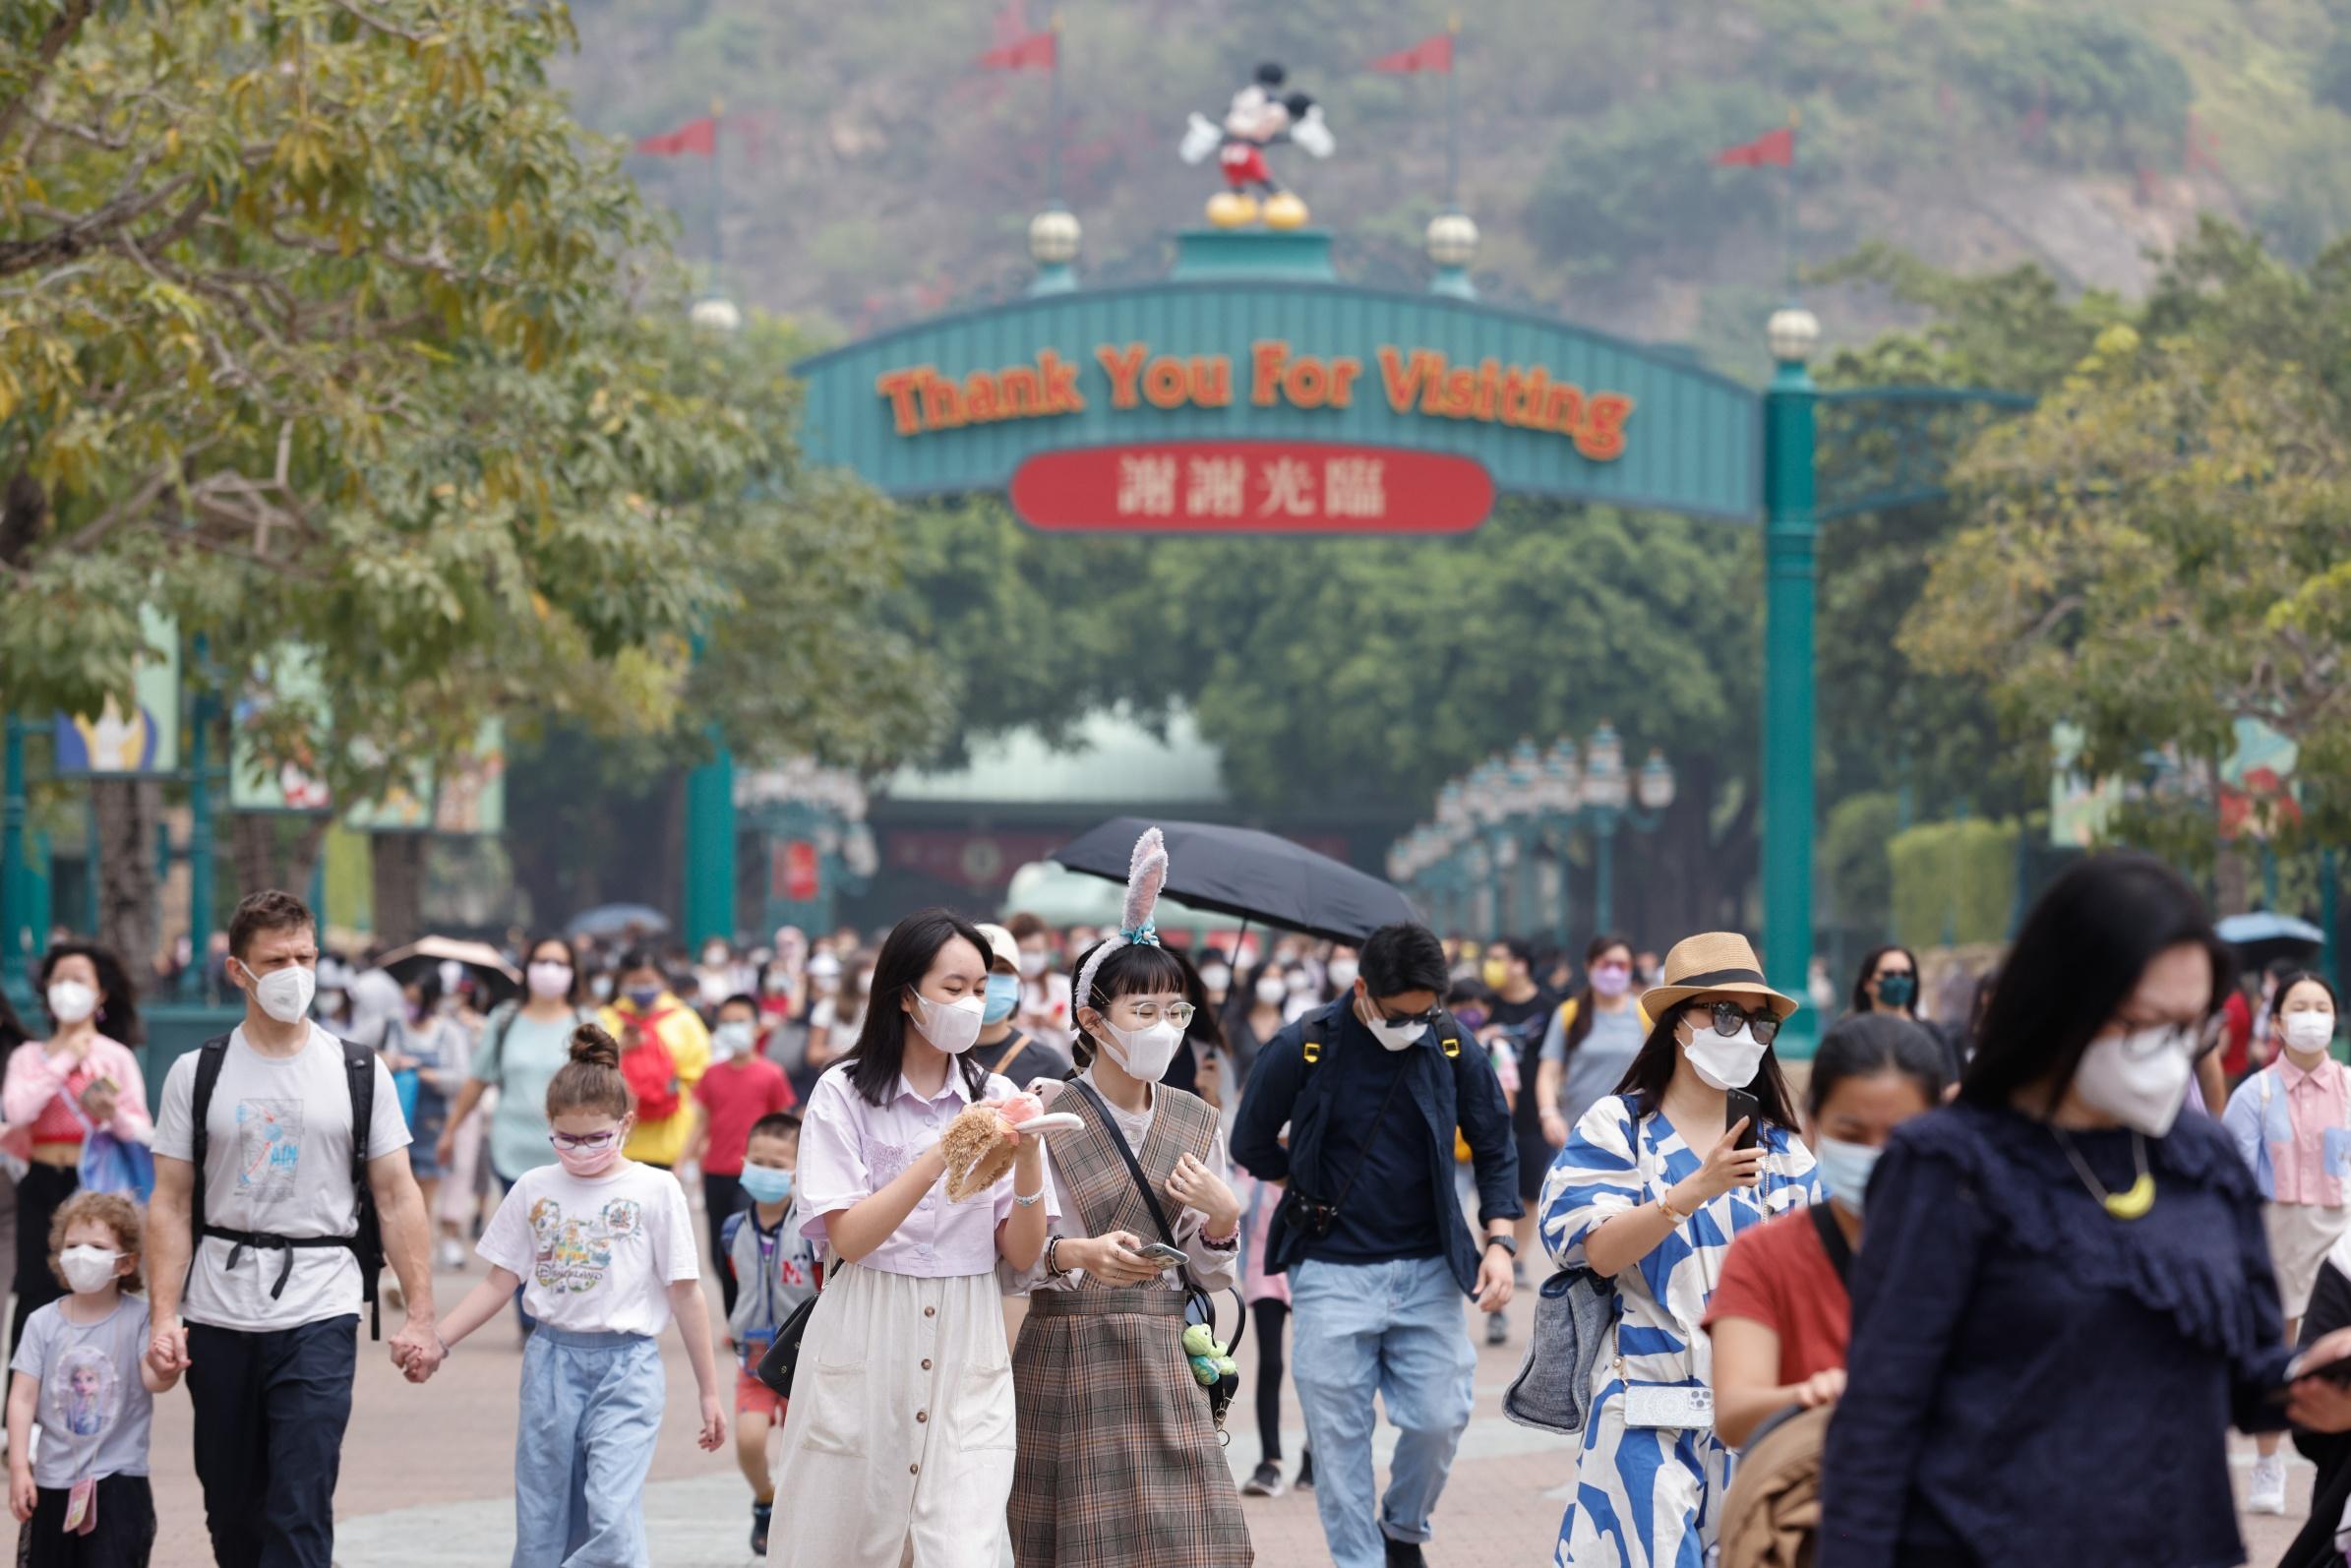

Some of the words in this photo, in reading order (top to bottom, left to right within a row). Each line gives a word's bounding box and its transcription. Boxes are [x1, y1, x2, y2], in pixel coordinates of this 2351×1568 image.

[876, 348, 1087, 435] Thank
[1095, 344, 1232, 409] You
[1251, 340, 1361, 409] For
[1378, 344, 1634, 460] Visiting
[1116, 453, 1386, 518] 謝謝光臨
